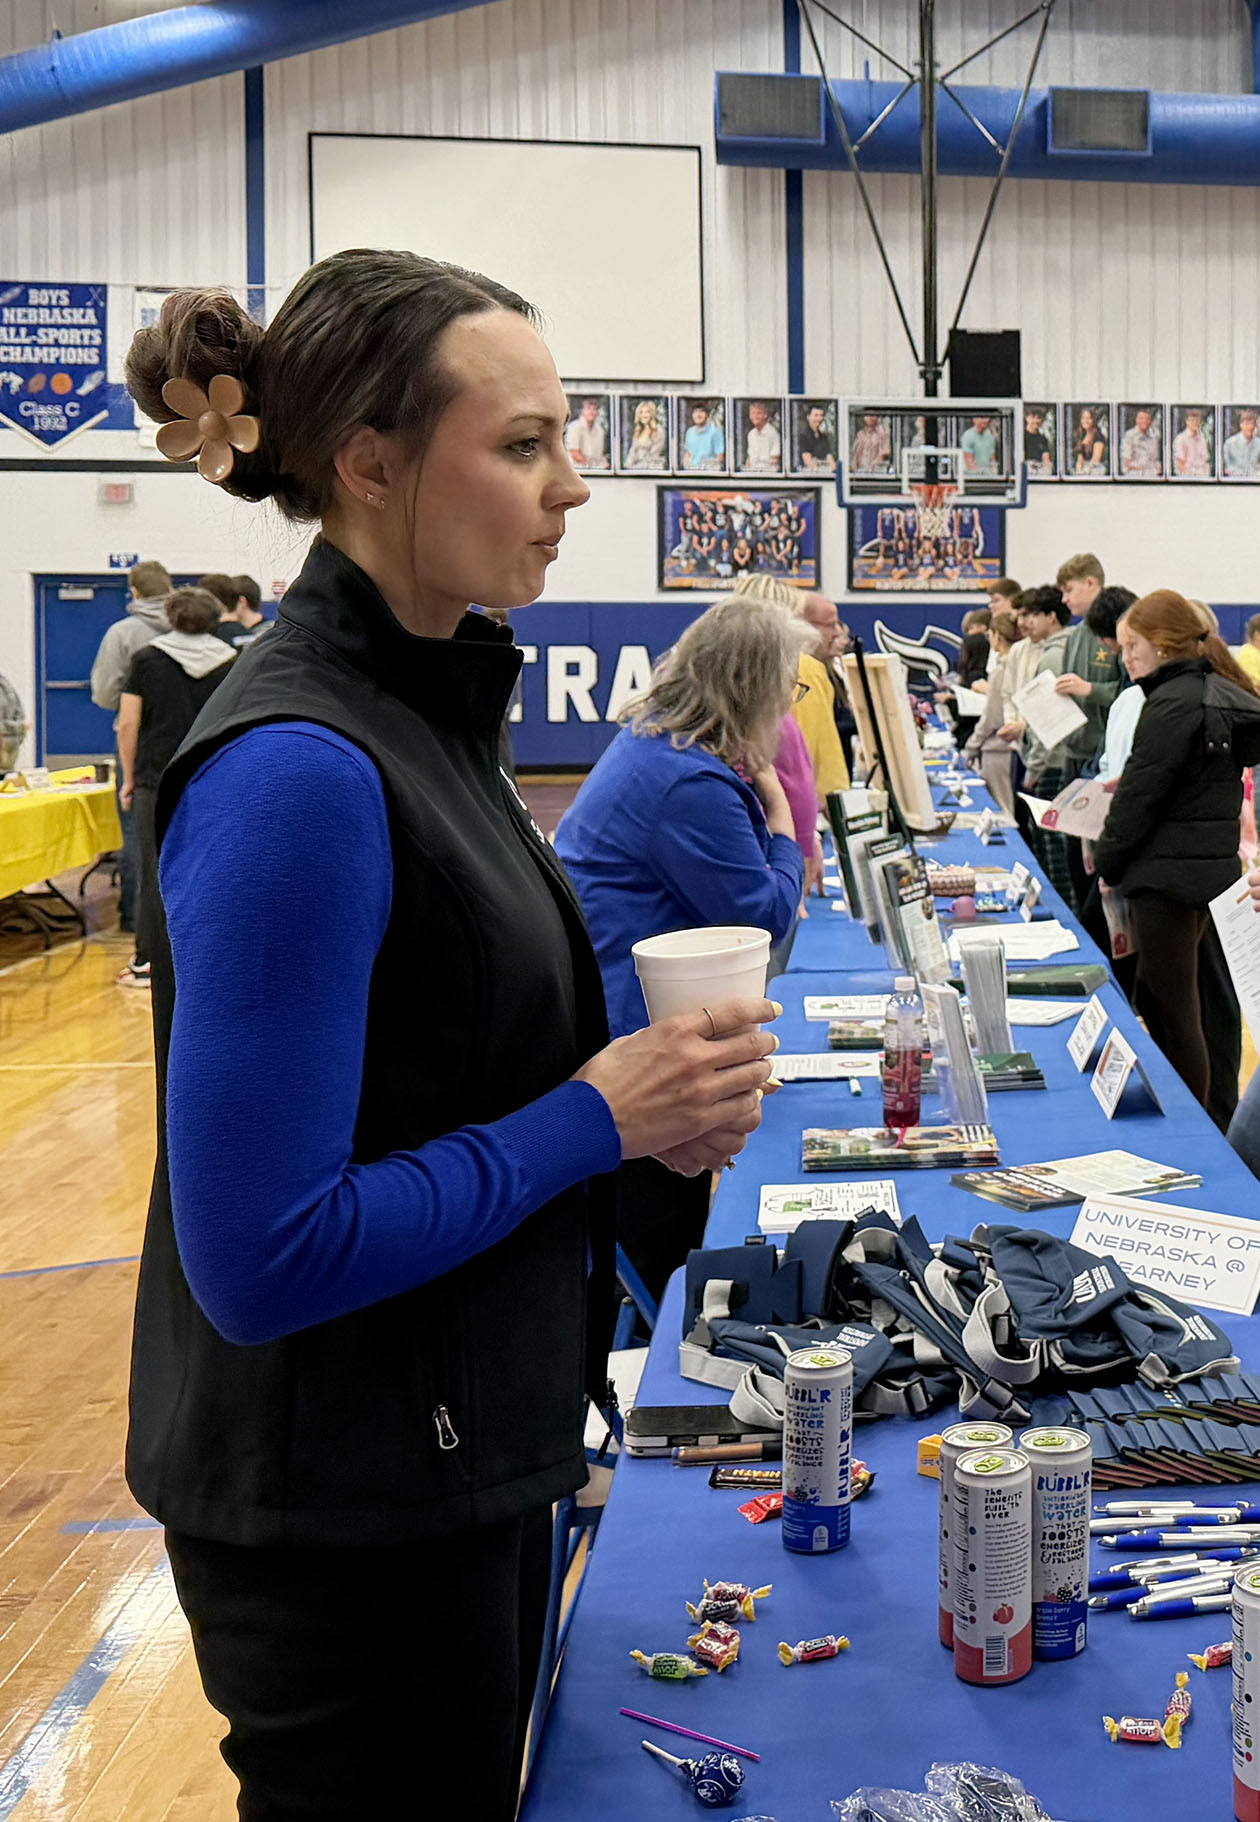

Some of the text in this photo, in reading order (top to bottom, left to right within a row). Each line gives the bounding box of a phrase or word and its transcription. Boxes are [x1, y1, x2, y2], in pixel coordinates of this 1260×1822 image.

[28, 288, 70, 306] BOYS
[2, 308, 97, 325] NEBRASKA
[0, 328, 102, 345] ALL-SPORTS
[0, 347, 99, 365] CHAMPIONS
[19, 402, 81, 417] Class C
[1084, 1209, 1221, 1244] UNIVERSITY
[1085, 1232, 1246, 1273] NEBRASKA @
[1117, 1261, 1217, 1291] EARNEY
